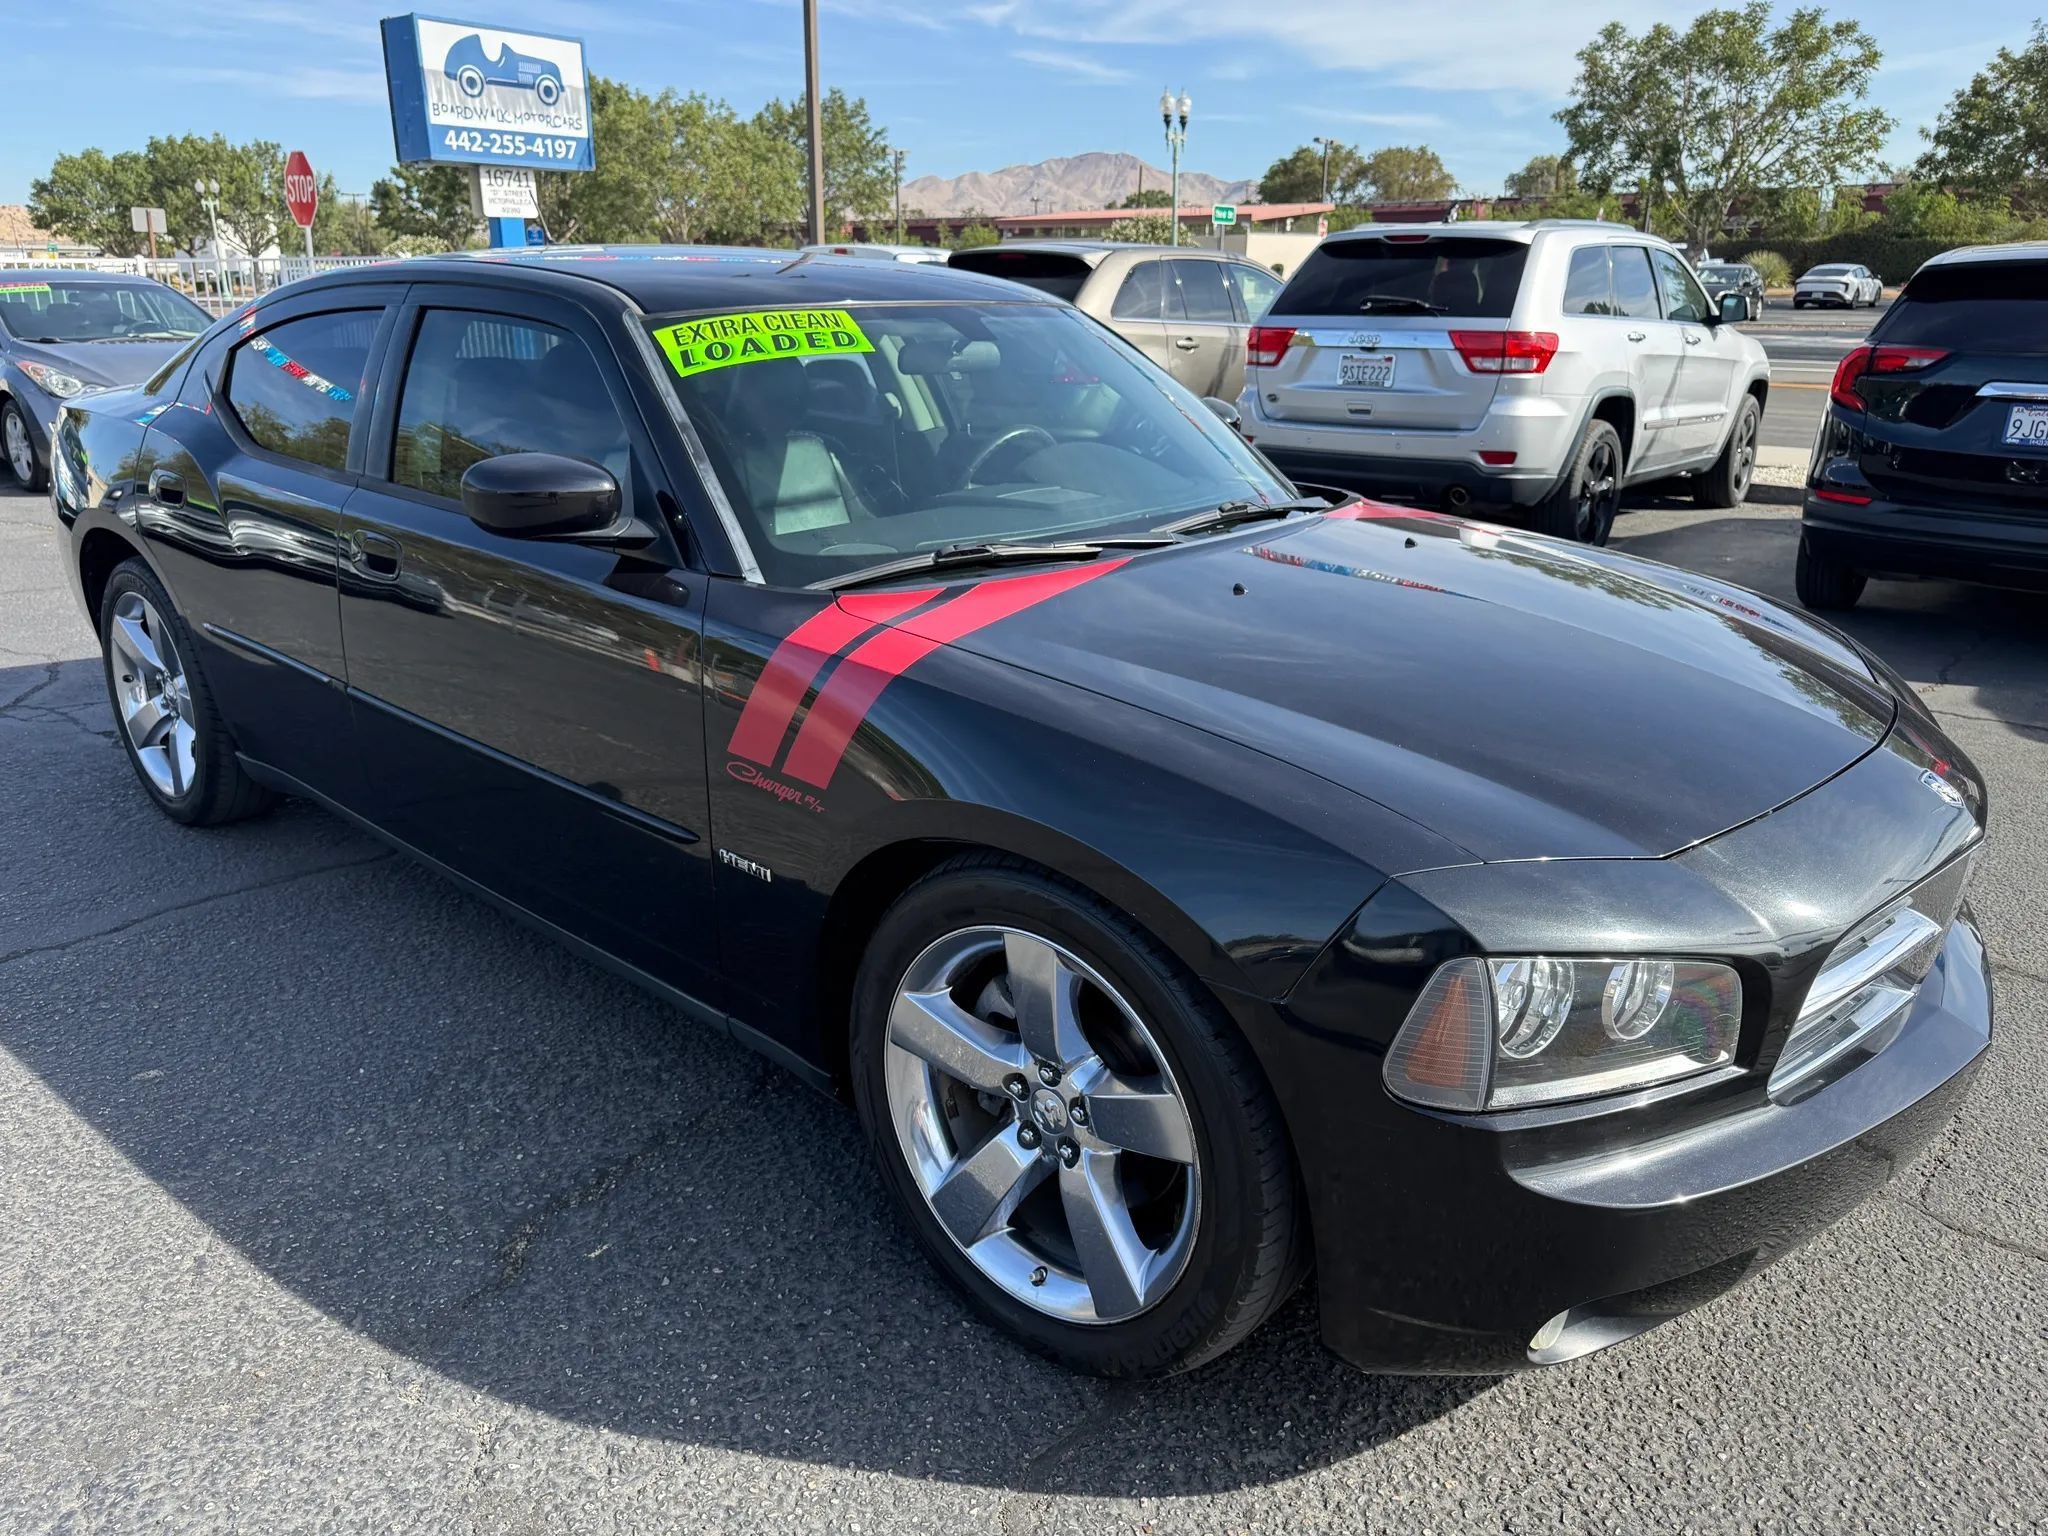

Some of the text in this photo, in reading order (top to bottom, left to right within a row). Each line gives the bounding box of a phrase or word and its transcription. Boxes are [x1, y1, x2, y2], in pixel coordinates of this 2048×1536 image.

[432, 103, 582, 130] BOARDWALK MOTORCARS
[444, 129, 577, 160] 442-255-4197
[287, 174, 314, 204] STOP
[485, 168, 531, 188] 16741
[671, 313, 846, 347] EXTRA CLEAN
[679, 330, 858, 369] LOADED
[2009, 418, 2048, 439] 9JG
[726, 761, 802, 805] Charger
[719, 847, 772, 882] HEMI
